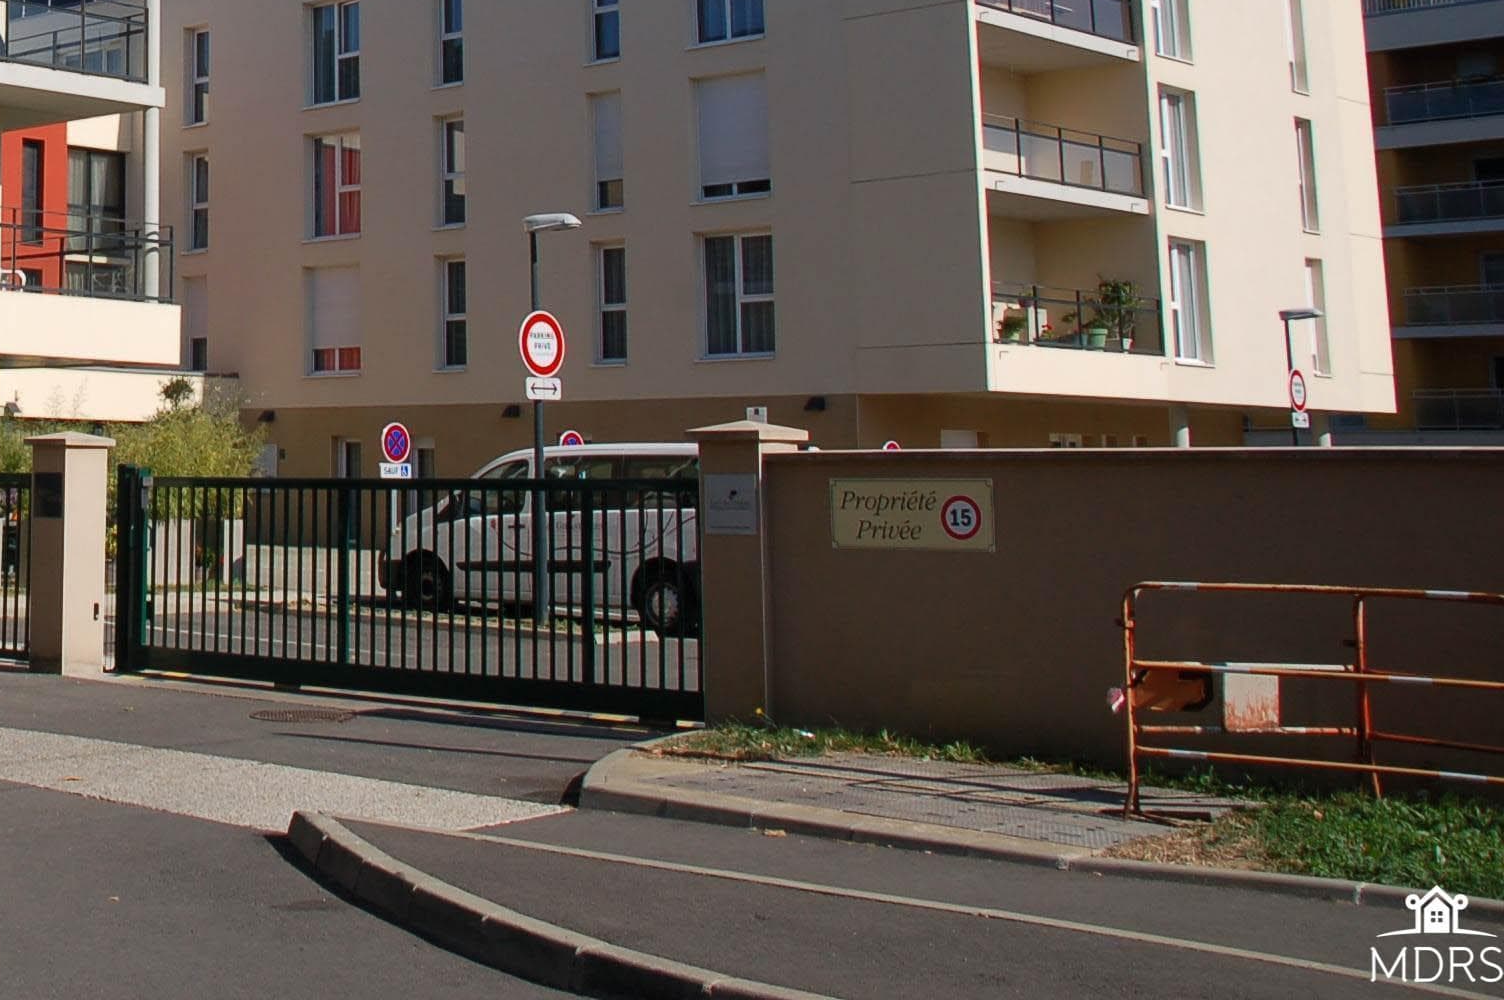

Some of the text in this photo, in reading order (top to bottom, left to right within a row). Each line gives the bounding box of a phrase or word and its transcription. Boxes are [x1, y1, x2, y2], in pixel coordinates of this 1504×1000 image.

[840, 490, 937, 516] Propriété
[949, 508, 973, 527] 15
[856, 519, 923, 541] Privée
